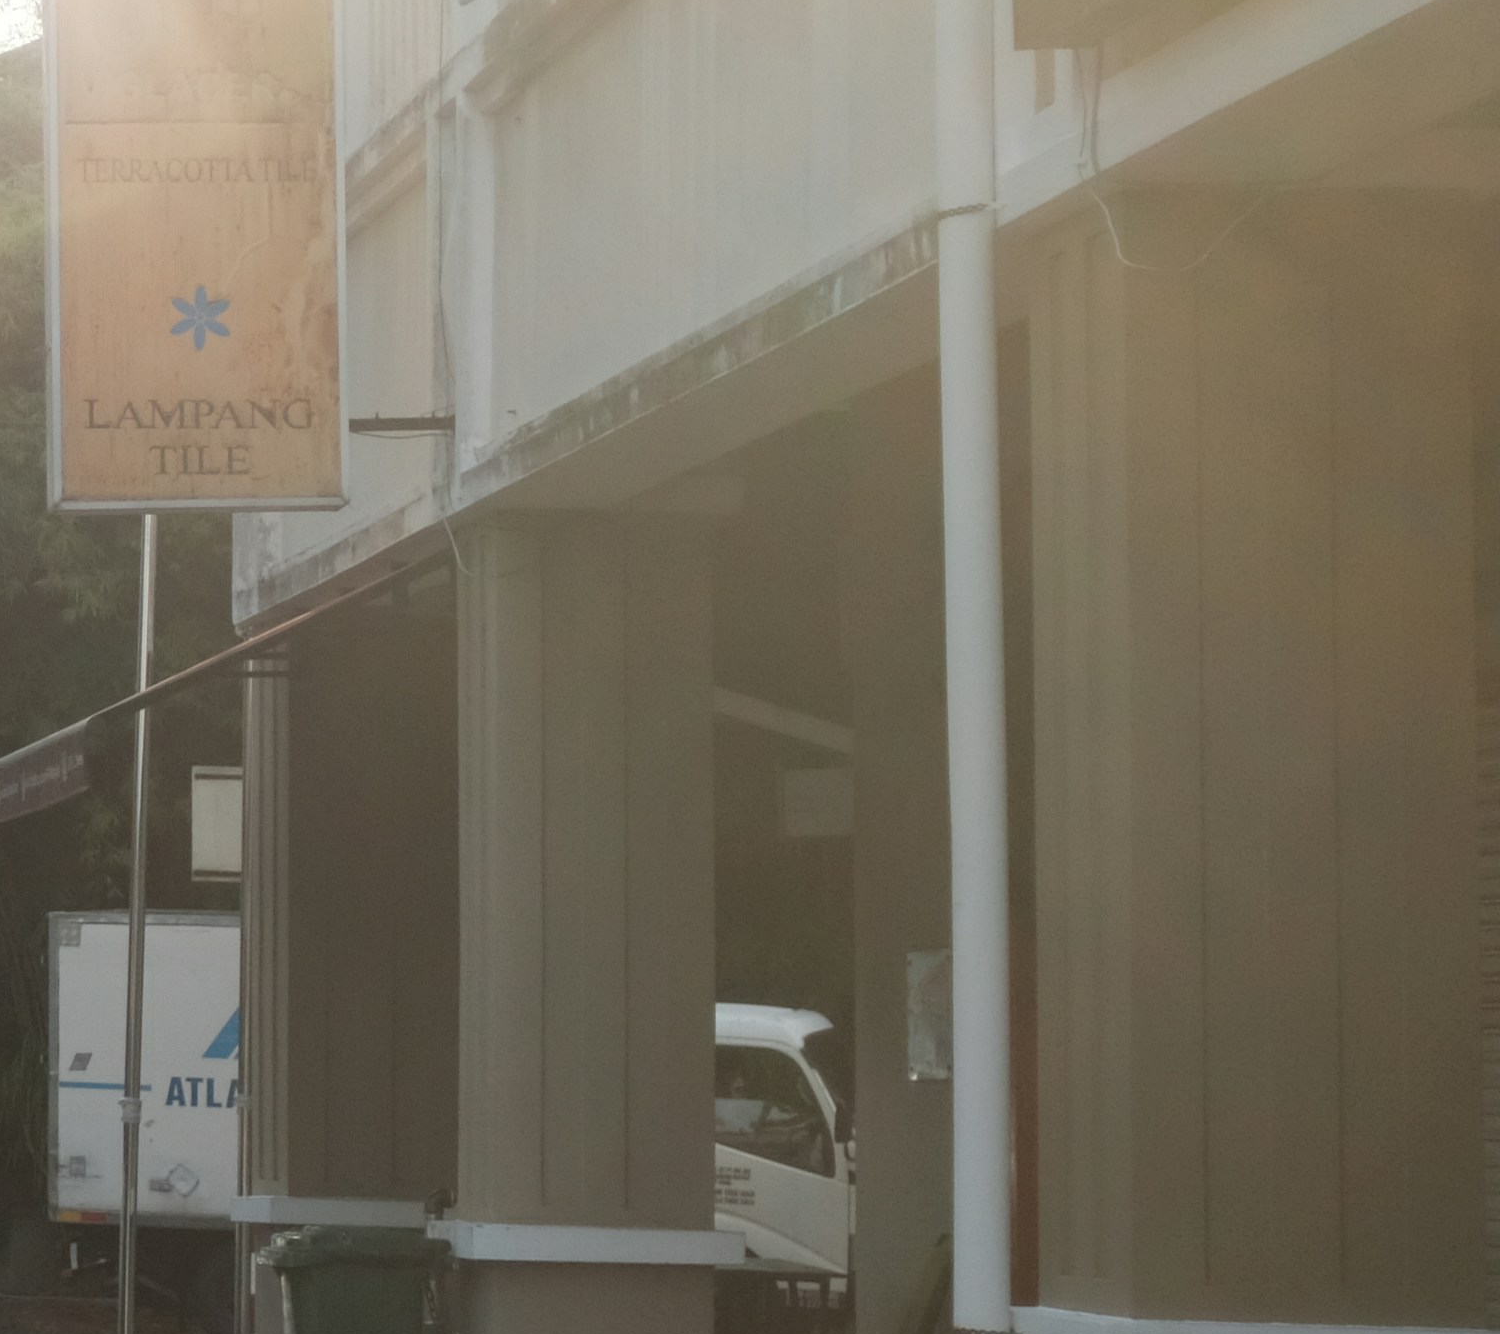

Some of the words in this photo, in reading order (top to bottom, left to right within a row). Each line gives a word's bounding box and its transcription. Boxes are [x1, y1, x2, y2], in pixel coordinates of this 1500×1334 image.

[77, 157, 254, 184] TERRACOTTA
[84, 397, 315, 430] LAMPANG
[149, 444, 252, 476] TILE
